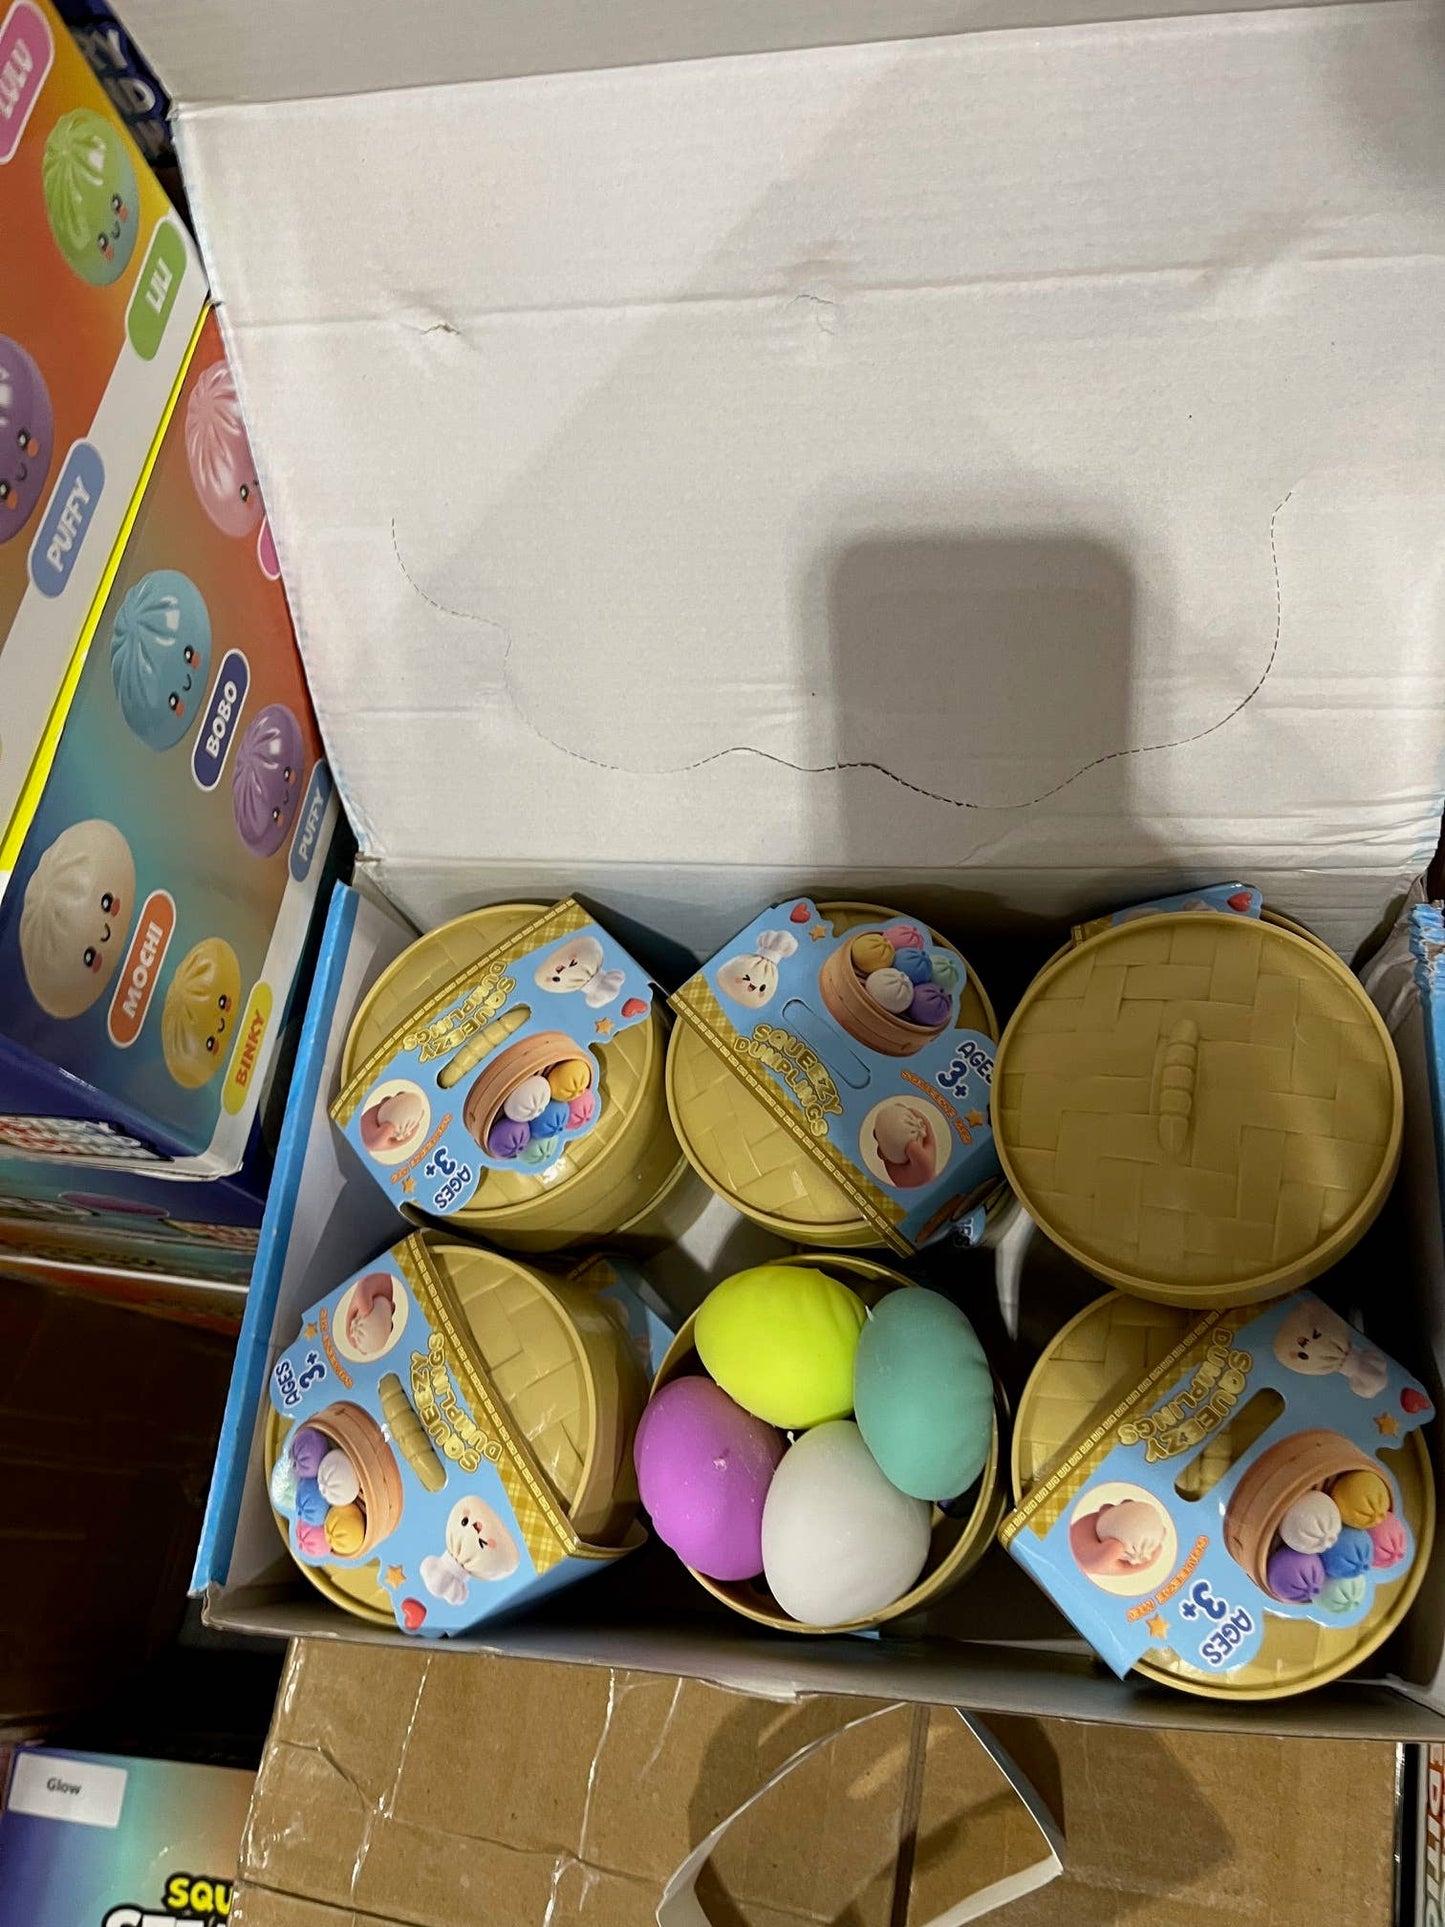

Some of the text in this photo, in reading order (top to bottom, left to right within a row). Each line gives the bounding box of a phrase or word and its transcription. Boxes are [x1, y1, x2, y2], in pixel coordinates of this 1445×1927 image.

[46, 475, 91, 573] PUFFY
[206, 680, 237, 759] BOBO
[298, 786, 324, 861] PUFFY
[122, 921, 164, 1019] MOCHI
[402, 961, 507, 1051] DUMPLINGS
[236, 1009, 265, 1087] BINKY
[418, 976, 516, 1063] SQUEEZY
[733, 1036, 830, 1137] DUMPLINGS
[752, 1023, 843, 1116] SQUEEZY
[937, 1060, 968, 1097] 3+
[425, 1147, 456, 1176] 3+
[434, 1164, 472, 1209] AGES
[275, 1360, 301, 1406] AGES
[299, 1352, 326, 1389] 3+
[427, 1331, 503, 1461] DUMPLINGS
[1117, 1327, 1233, 1446] DUMPLINGS
[1145, 1350, 1253, 1464] SQUEEZY
[410, 1350, 481, 1472] SQUEEZY
[1181, 1581, 1227, 1620] 3+
[1202, 1608, 1253, 1665] AGES
[46, 1777, 82, 1795] Glow
